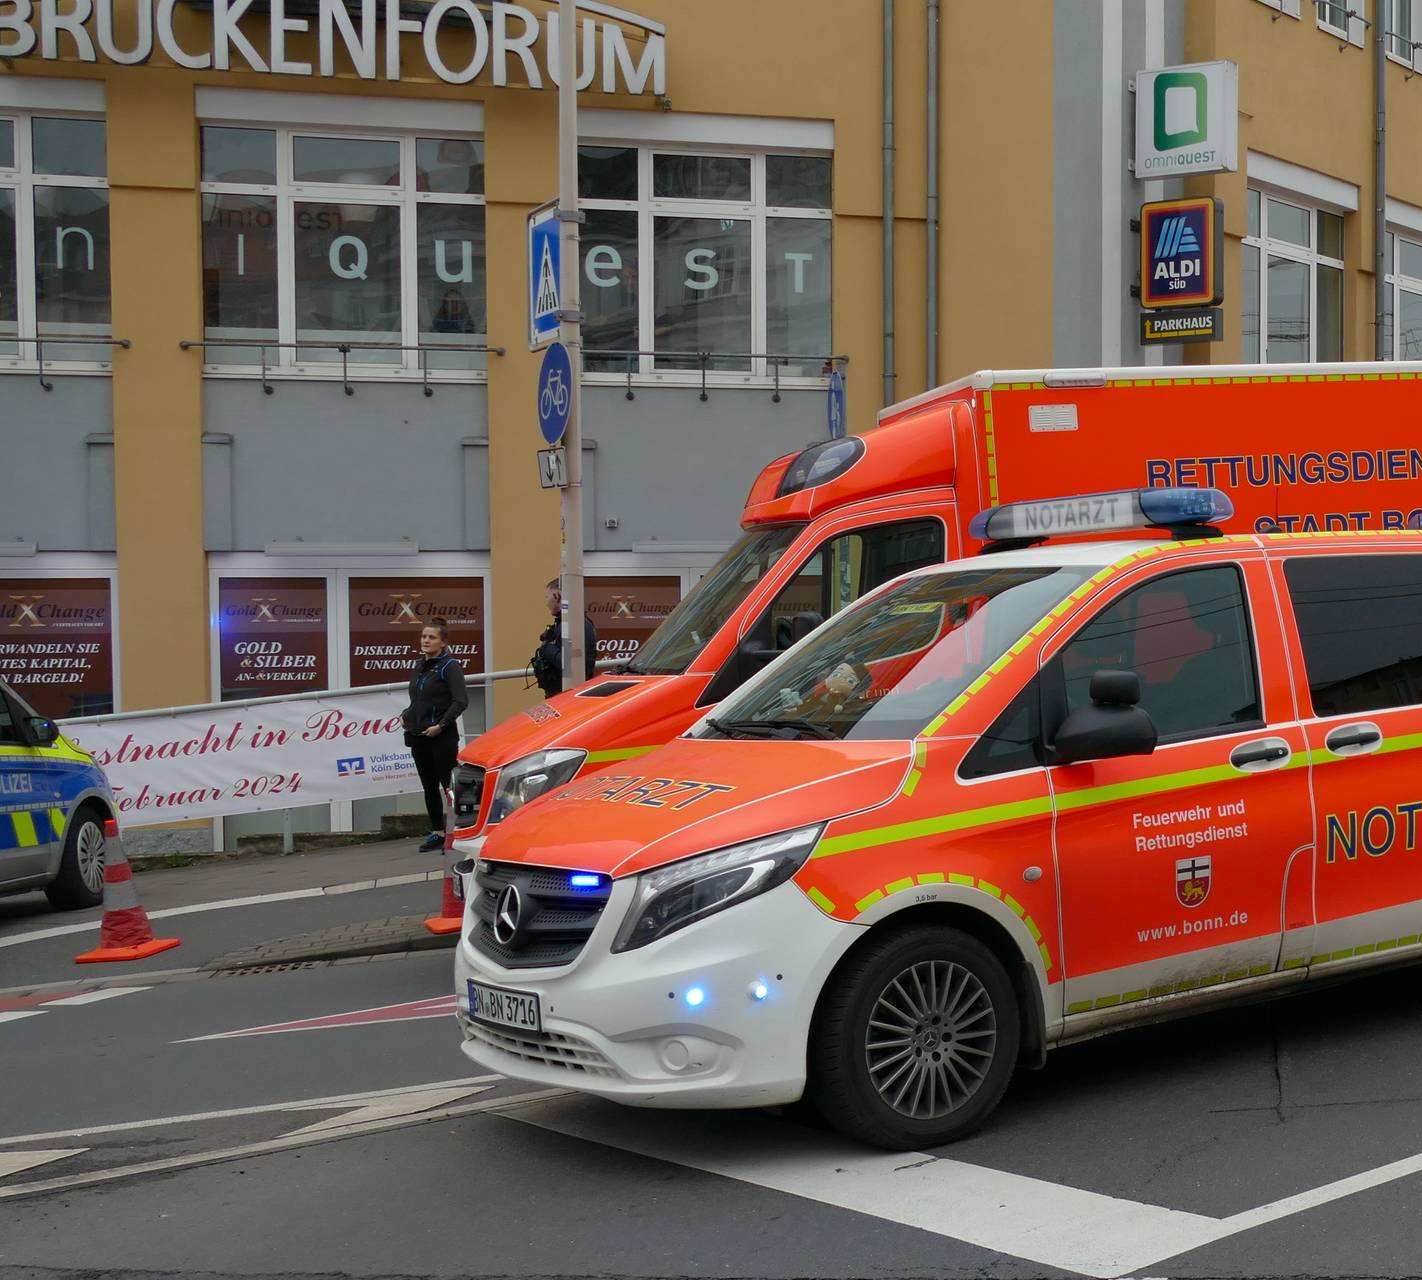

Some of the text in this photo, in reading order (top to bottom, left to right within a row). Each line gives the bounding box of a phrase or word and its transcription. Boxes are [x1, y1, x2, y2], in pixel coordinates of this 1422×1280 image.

[1154, 258, 1201, 280] ALDI
[1168, 278, 1186, 290] SÜD
[1153, 316, 1213, 332] PARKHAUS
[1025, 498, 1119, 531] NOTARZT
[1253, 512, 1372, 534] STADT
[77, 643, 100, 653] SIE
[234, 641, 282, 654] GOLD
[354, 645, 411, 656] DISKRET
[596, 639, 639, 651] GOLD
[0, 658, 91, 669] TES KAPITAL,
[254, 655, 317, 668] SILBER
[13, 672, 84, 683] BARGELD!
[90, 708, 402, 768] stnacht in Beue
[370, 752, 413, 764] Volksban
[371, 763, 392, 773] Köln
[0, 773, 33, 794] LIZEI
[232, 771, 303, 799] 2024
[555, 776, 736, 811] TARZT
[1132, 799, 1246, 829] Feuerwehr und
[1135, 822, 1249, 852] Rettungsdienst
[1137, 910, 1249, 943] www.bonn.de
[474, 986, 536, 1026] BN BN 3716
